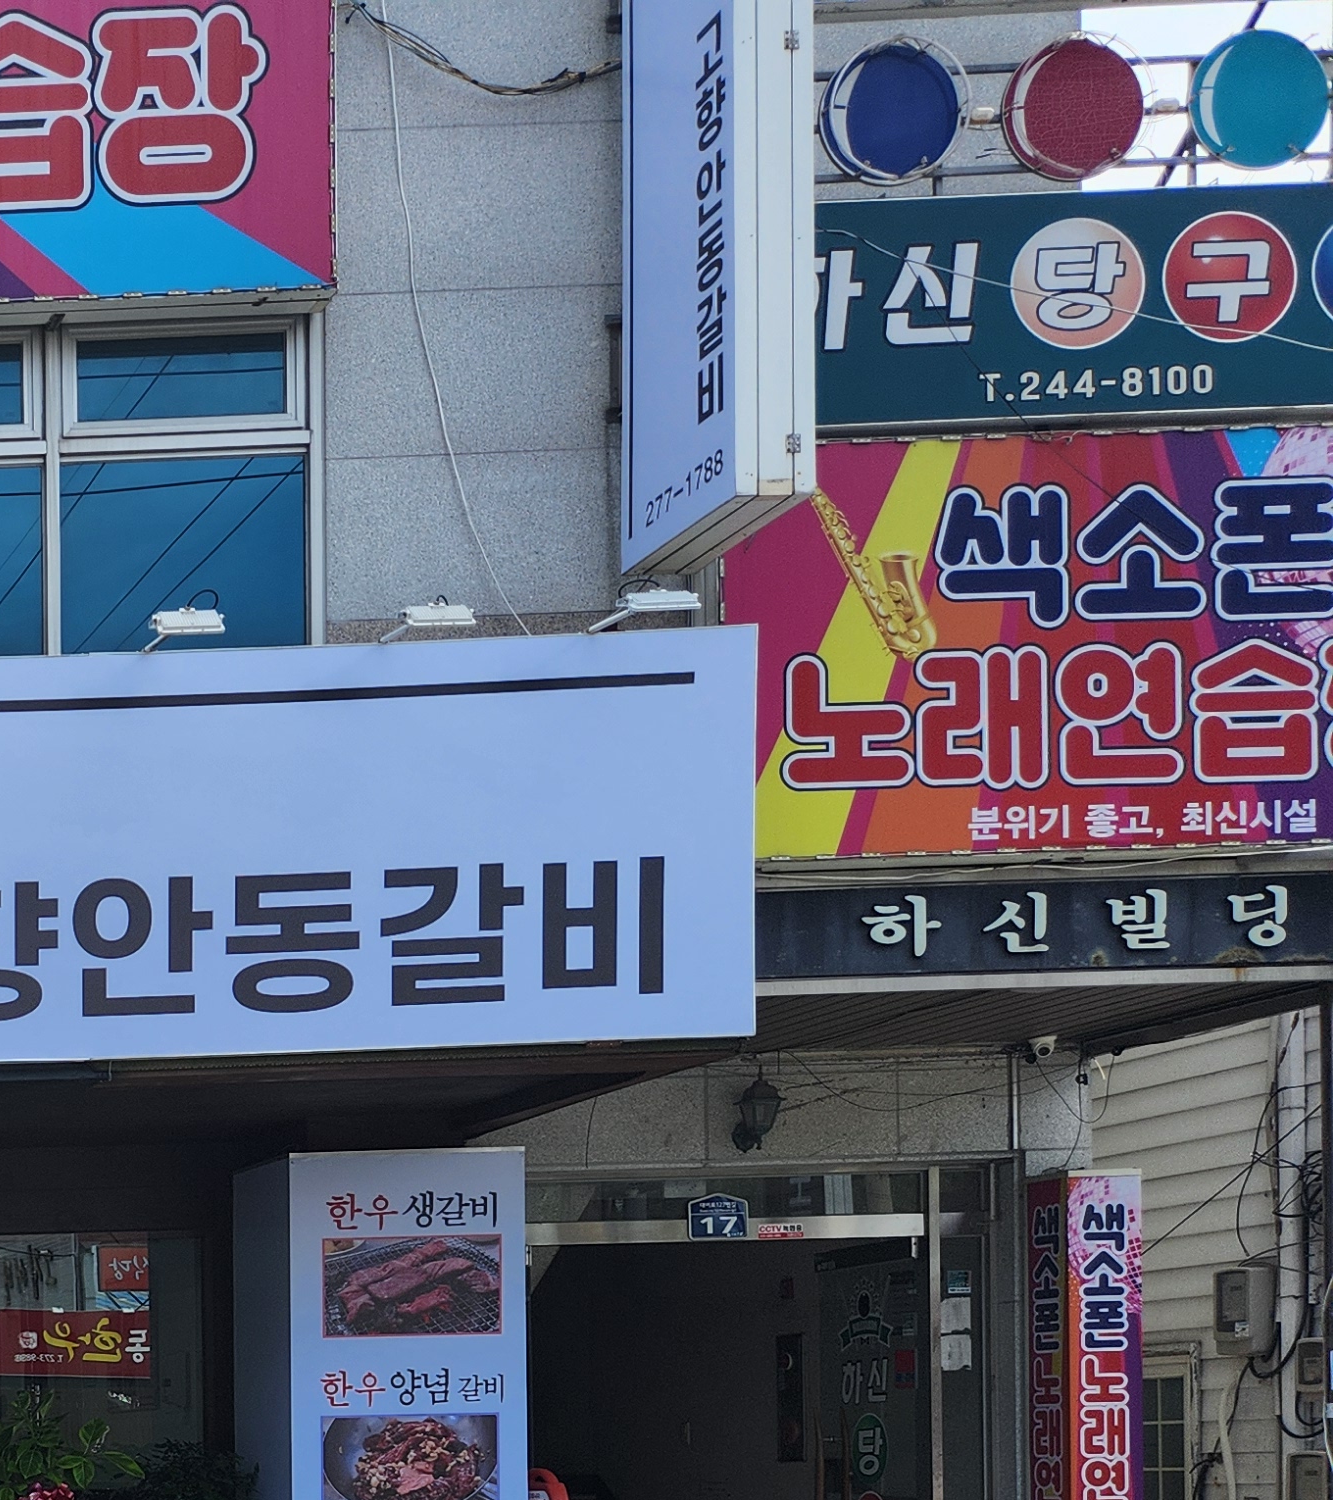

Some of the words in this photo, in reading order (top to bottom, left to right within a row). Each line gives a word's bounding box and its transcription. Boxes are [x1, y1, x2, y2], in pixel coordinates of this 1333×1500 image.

[695, 10, 728, 425] 고향안동갈비
[979, 364, 1214, 402] T.244-8100
[645, 449, 724, 528] 277-1788
[780, 635, 1333, 791] 노래연습
[968, 804, 1071, 841] 분위기
[1084, 803, 1164, 839] 좋고,
[1180, 799, 1318, 836] 최신시설
[326, 1193, 399, 1232] 한우
[402, 1191, 499, 1229] 생갈비
[699, 1216, 738, 1235] 17
[320, 1370, 387, 1408] 한우
[389, 1367, 450, 1406] 양념
[457, 1373, 506, 1405] 갈비
[840, 1357, 889, 1405] 하신
